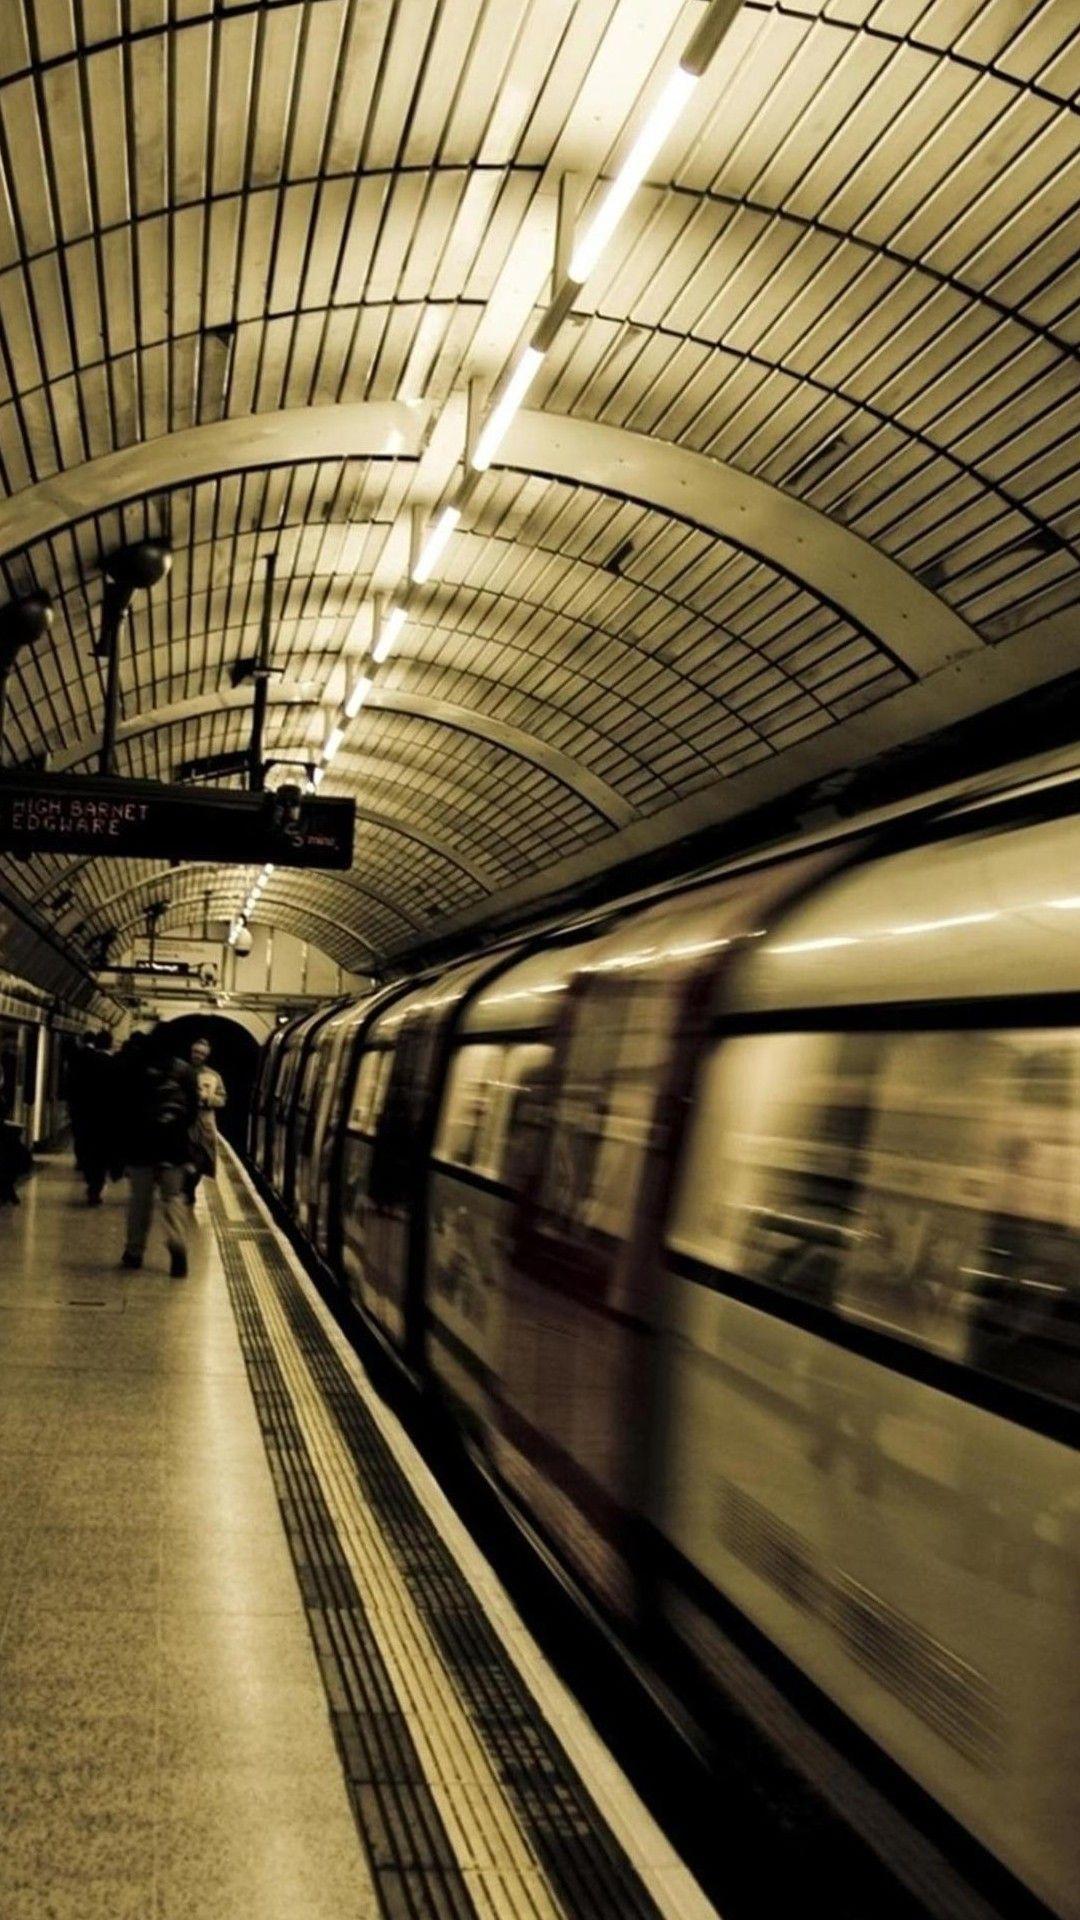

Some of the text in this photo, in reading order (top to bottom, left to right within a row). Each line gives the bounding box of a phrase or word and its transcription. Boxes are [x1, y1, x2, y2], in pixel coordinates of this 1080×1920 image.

[12, 798, 149, 821] HIGH BARNET
[12, 813, 120, 835] EDGWARE
